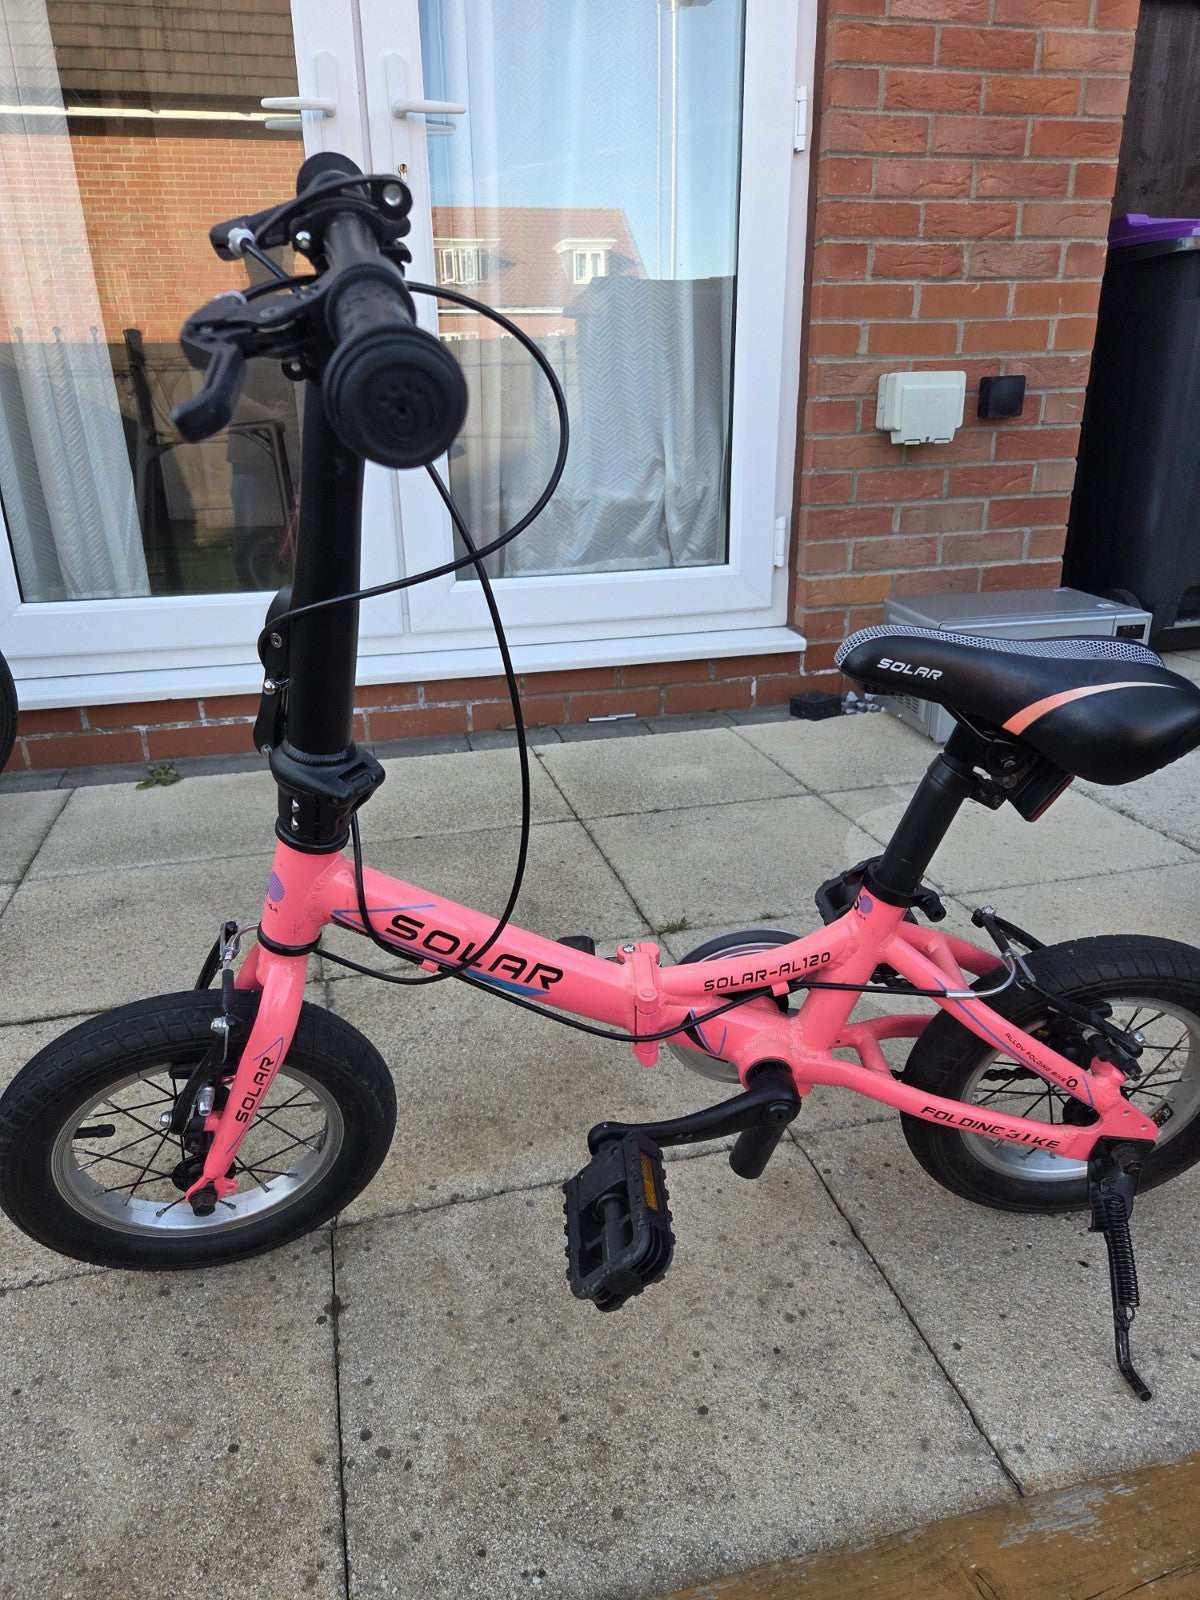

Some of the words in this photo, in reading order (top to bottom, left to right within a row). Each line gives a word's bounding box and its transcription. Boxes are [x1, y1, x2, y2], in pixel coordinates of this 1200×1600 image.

[877, 657, 943, 681] SOLAR
[385, 914, 564, 990] SOLAR
[704, 952, 830, 992] SOLAR-AL120
[1005, 1032, 1026, 1051] ALLOY
[235, 1056, 275, 1124] SOLAR
